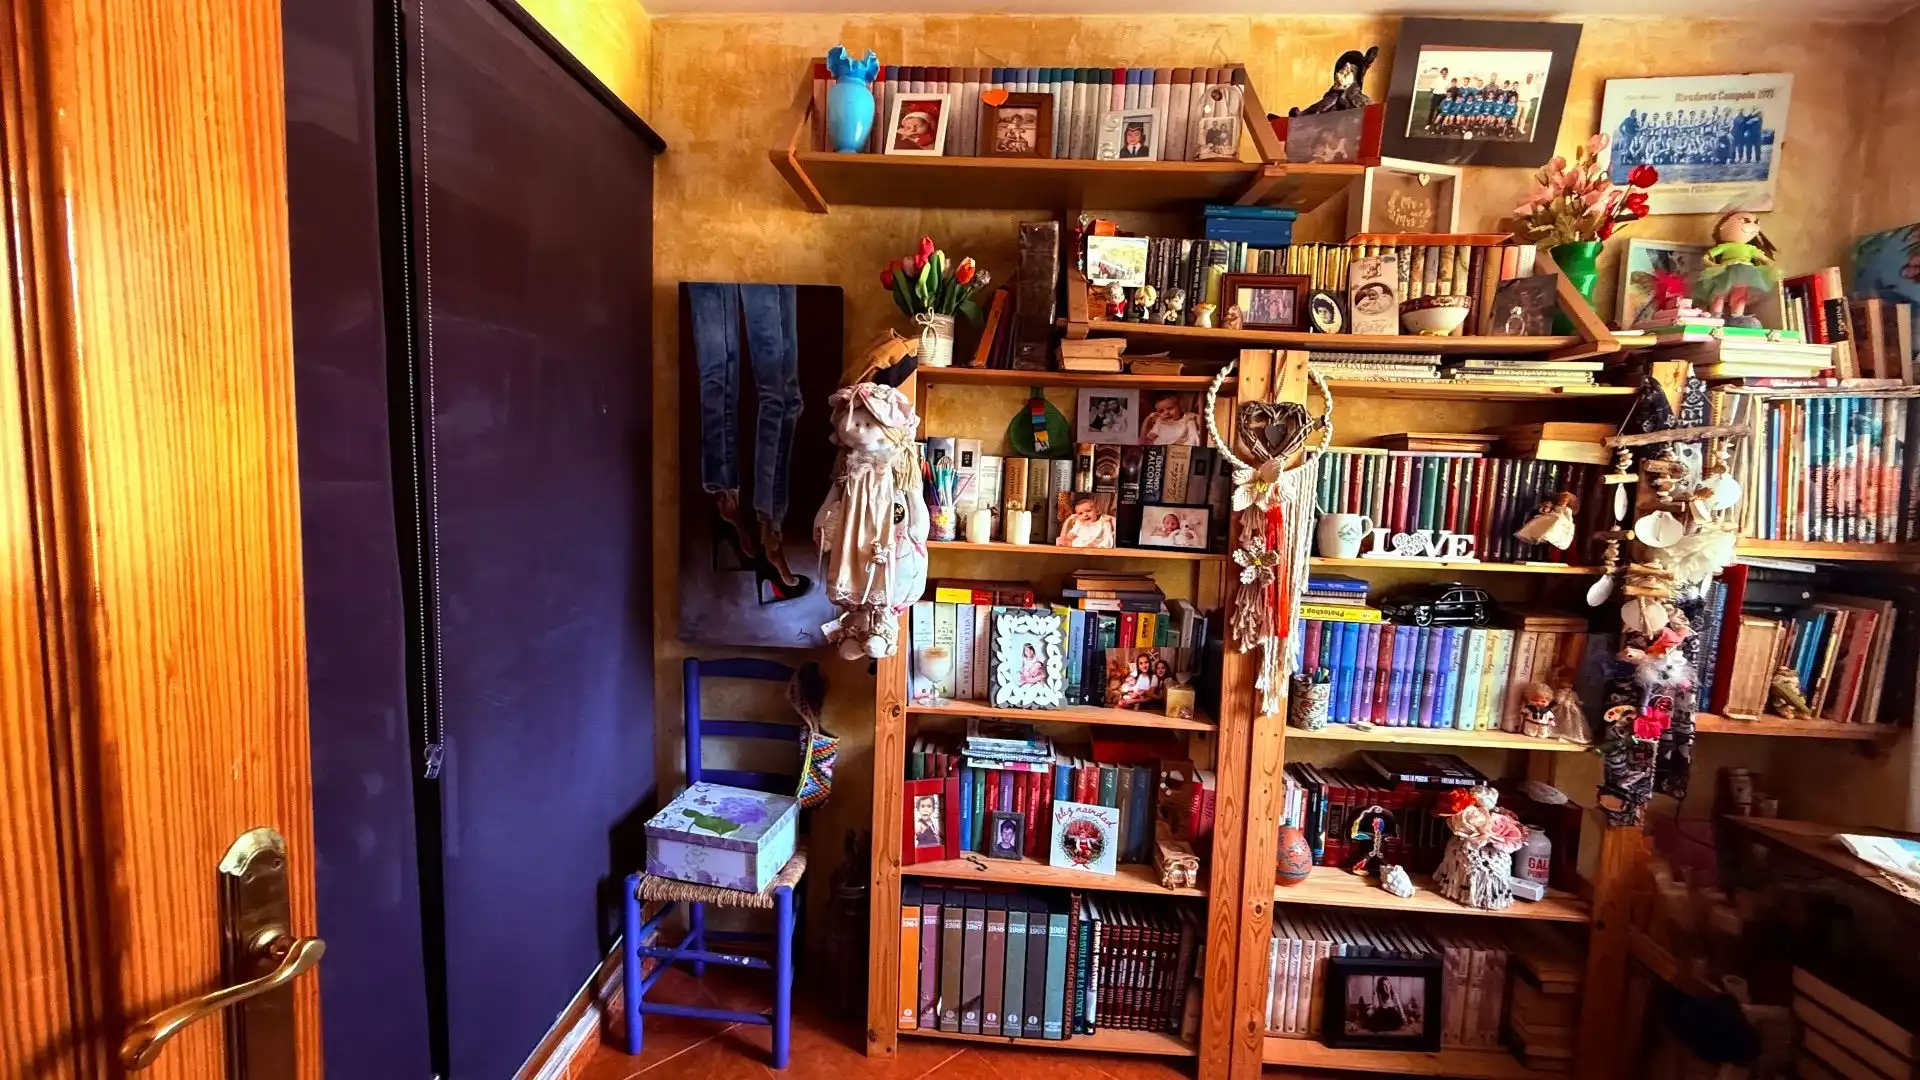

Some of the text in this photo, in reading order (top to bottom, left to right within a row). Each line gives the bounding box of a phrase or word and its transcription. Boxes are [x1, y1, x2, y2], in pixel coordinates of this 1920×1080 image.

[1145, 450, 1157, 495] FALCONES
[1153, 455, 1163, 491] ILDEFONSO
[1306, 607, 1345, 618] Photoshop
[944, 921, 962, 930] 1986
[965, 922, 984, 931] 1987
[1092, 920, 1102, 954] GRANDES
[1077, 923, 1088, 968] MARAVILLAS
[1074, 989, 1085, 1018] CIENCIA
